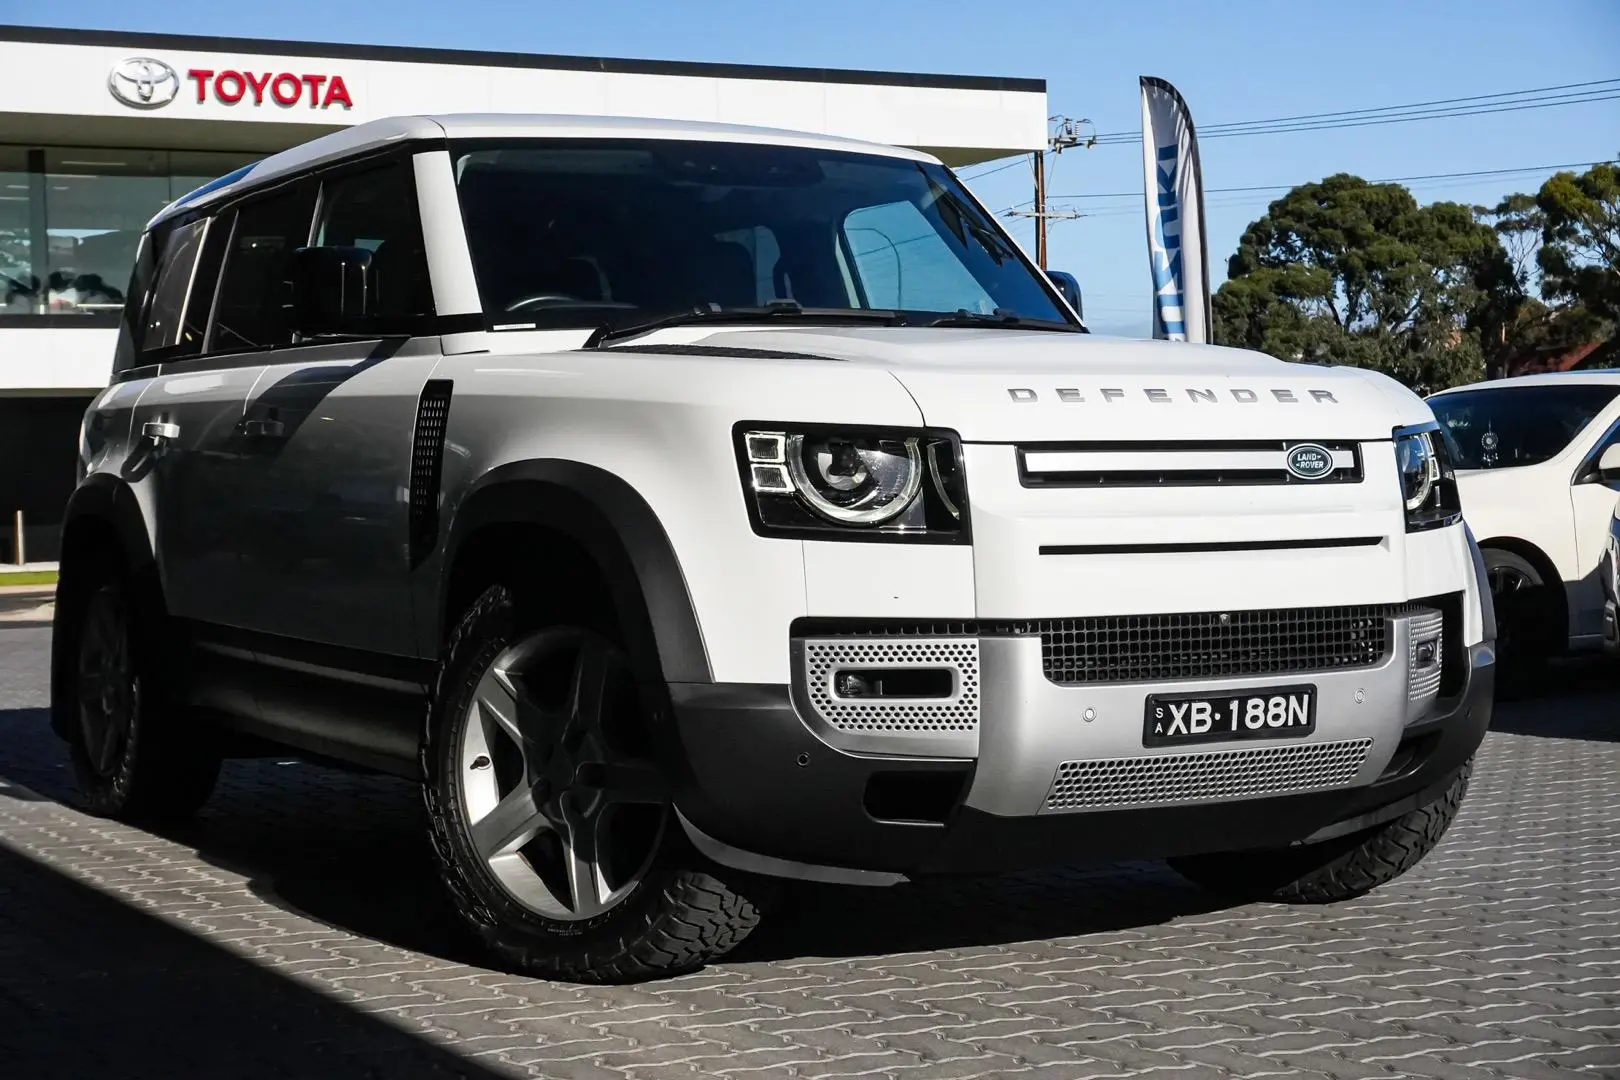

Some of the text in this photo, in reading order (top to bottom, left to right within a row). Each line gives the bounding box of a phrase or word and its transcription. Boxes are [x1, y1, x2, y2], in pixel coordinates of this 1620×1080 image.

[188, 69, 353, 108] TOYOTA
[1007, 388, 1339, 403] DEFENDER
[1297, 453, 1317, 461] LAND
[1300, 461, 1324, 469] ROVER
